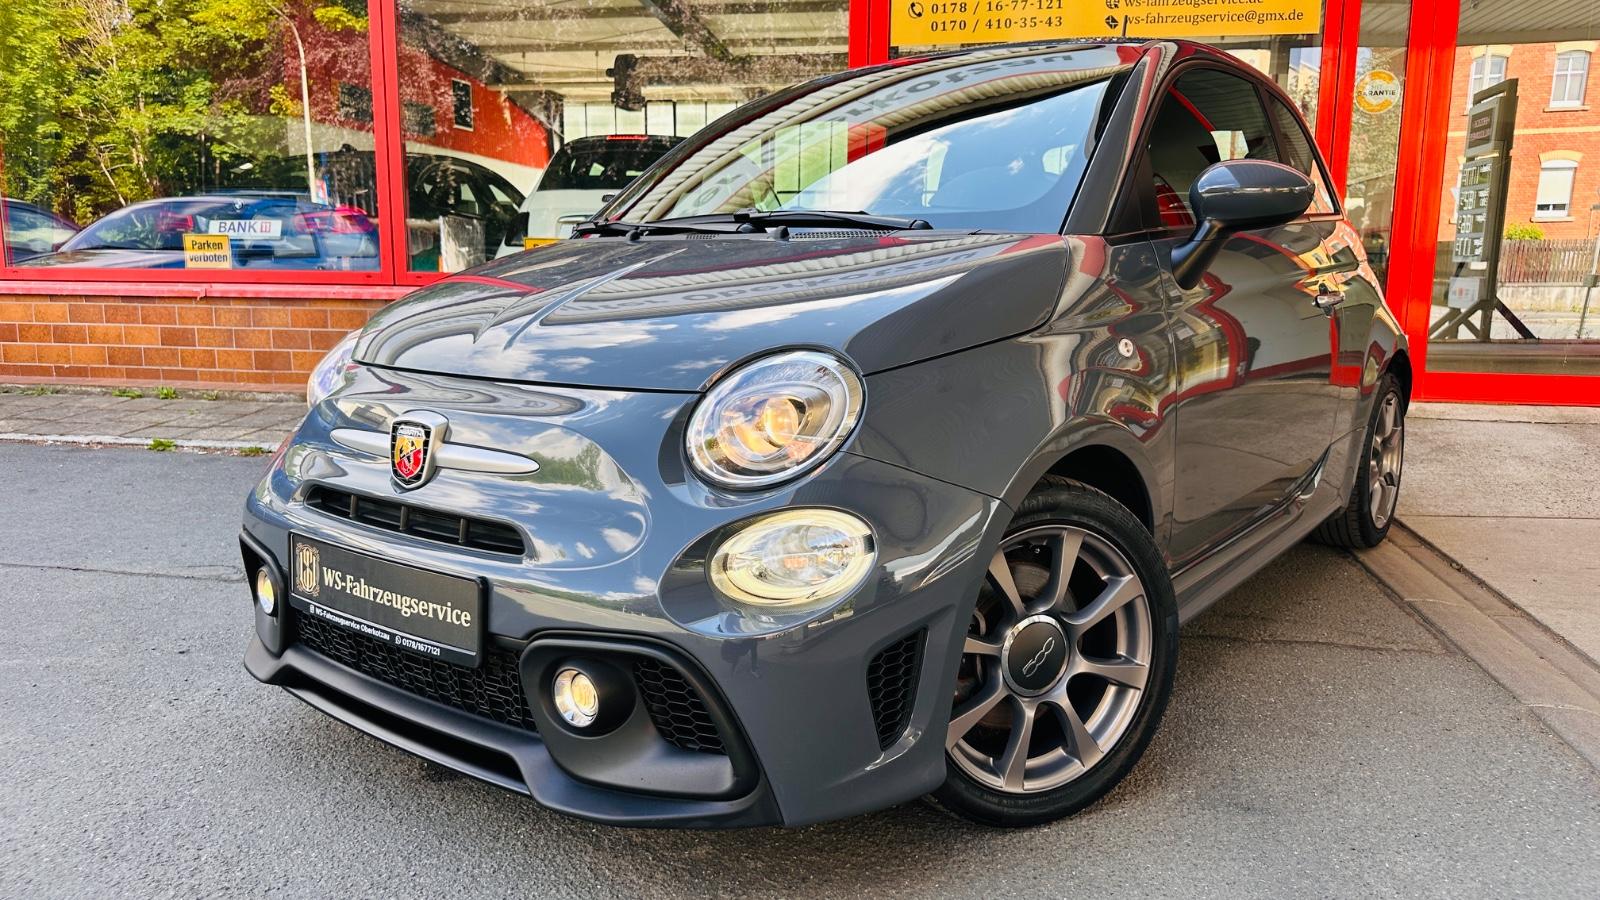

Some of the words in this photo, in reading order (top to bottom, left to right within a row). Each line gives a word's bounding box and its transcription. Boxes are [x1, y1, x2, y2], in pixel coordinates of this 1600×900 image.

[931, 2, 968, 14] 0178
[986, 0, 1064, 12] 16-77-121
[930, 20, 967, 32] 0170
[985, 16, 1063, 29] 410-35-43
[191, 239, 223, 250] Parken
[189, 253, 228, 262] verboten
[322, 565, 472, 628] WS-Fahrzeugservice
[315, 607, 360, 630] WS-Fahrzeugservice
[361, 624, 390, 640] Oberkotzau
[402, 638, 441, 656] 0178/1677121
